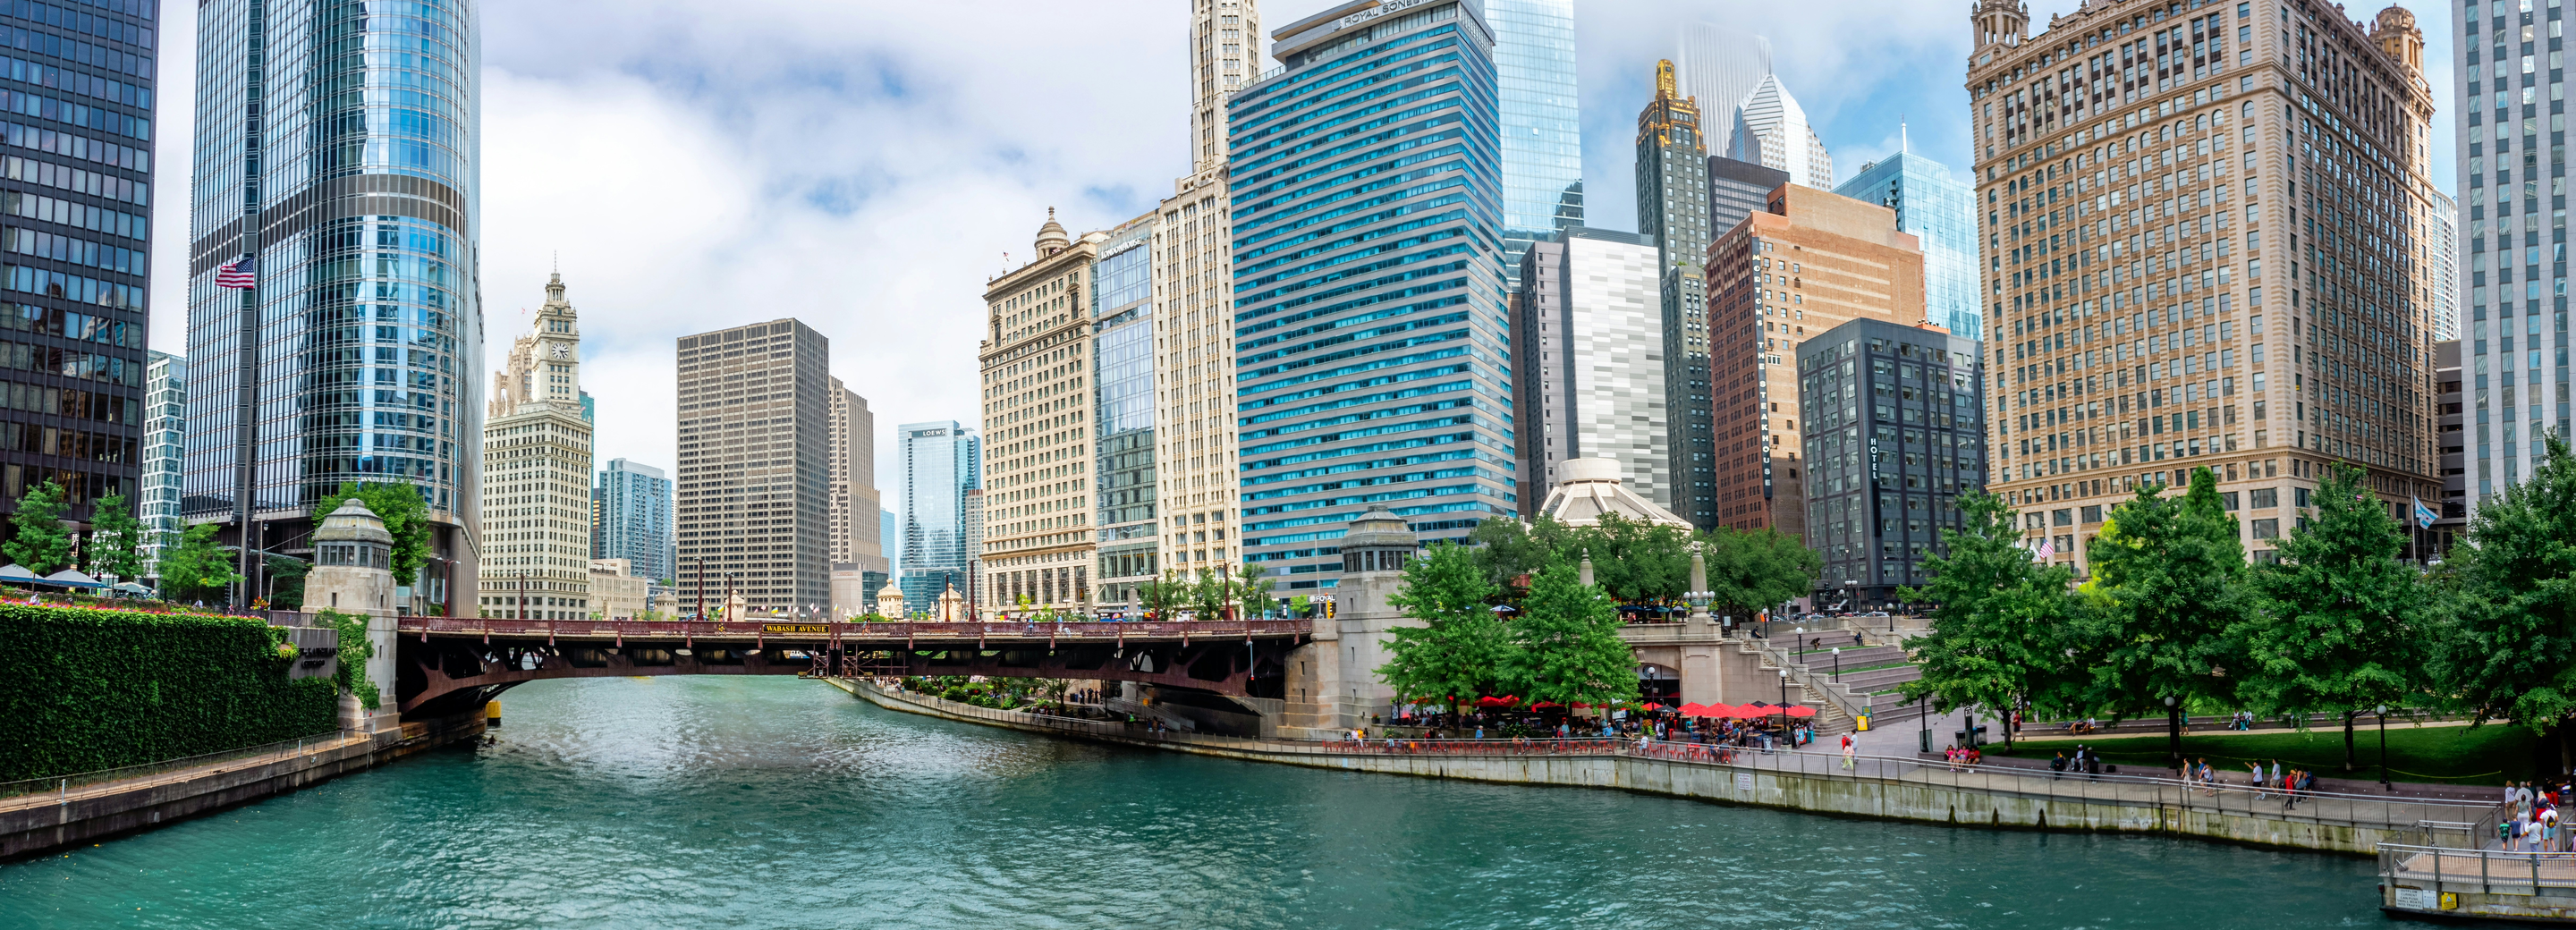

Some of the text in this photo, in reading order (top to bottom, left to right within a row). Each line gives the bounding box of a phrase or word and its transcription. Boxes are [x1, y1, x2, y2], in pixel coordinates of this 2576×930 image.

[1344, 9, 1379, 26] ROYAL
[1758, 342, 1766, 370] THE
[1759, 380, 1771, 486] STEAKHOUSE
